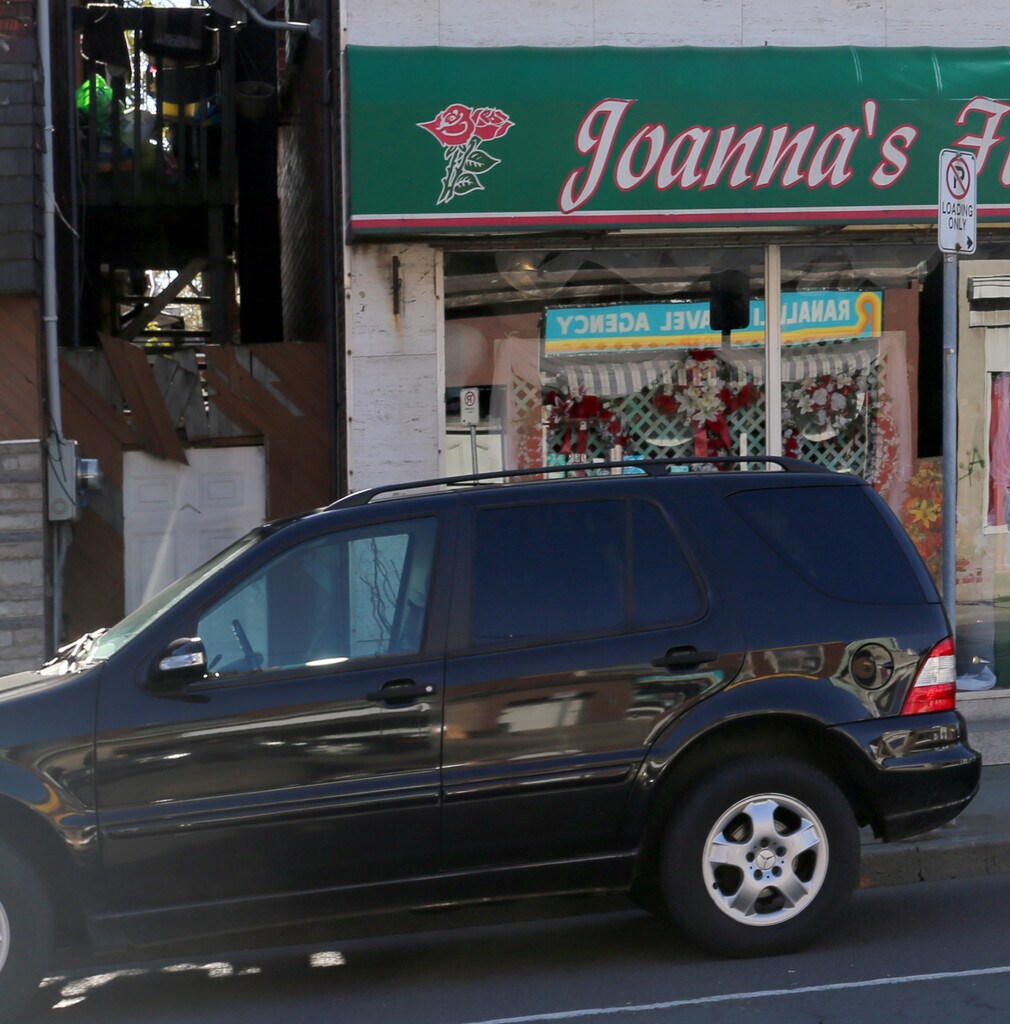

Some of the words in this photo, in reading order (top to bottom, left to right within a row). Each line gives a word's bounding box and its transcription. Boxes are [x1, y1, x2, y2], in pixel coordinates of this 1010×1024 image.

[559, 98, 919, 214] Joanna's
[942, 201, 973, 217] LOADING
[948, 217, 967, 231] ONLY
